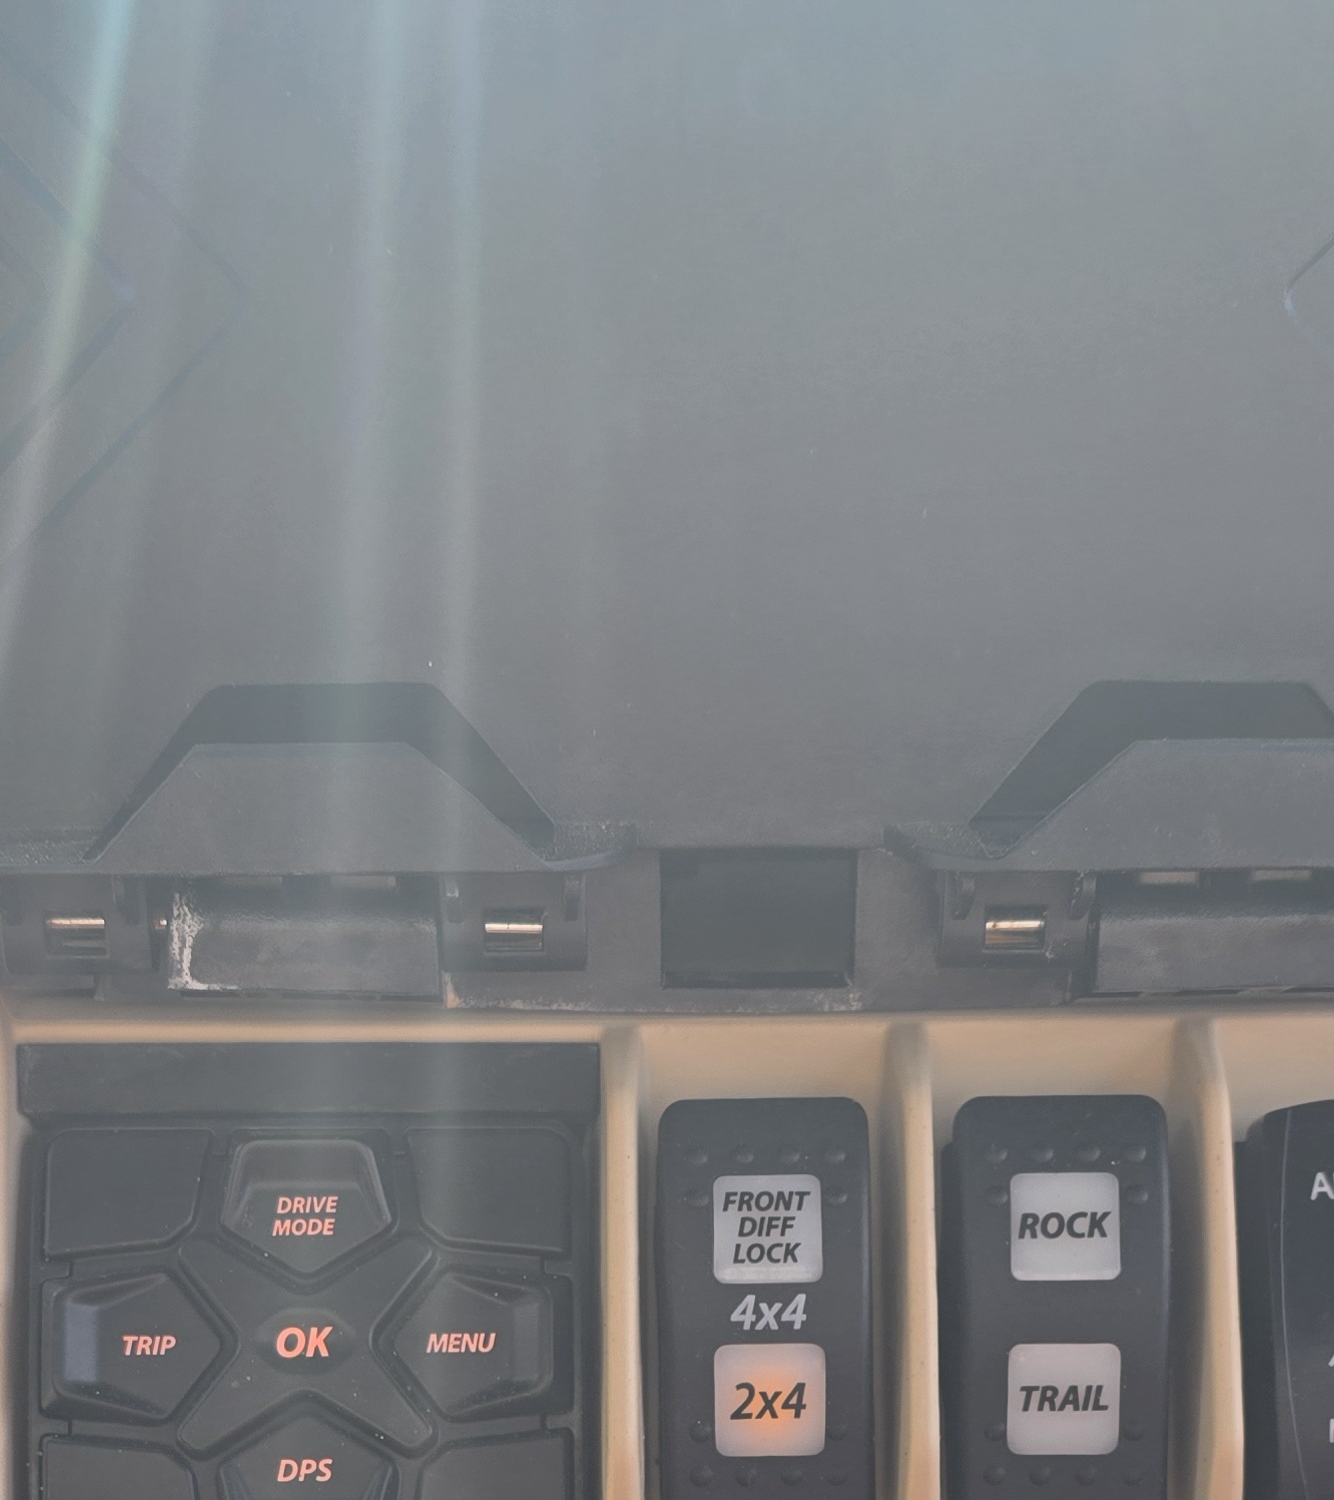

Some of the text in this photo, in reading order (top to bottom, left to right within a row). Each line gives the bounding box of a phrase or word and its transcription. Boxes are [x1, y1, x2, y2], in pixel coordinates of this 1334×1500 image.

[276, 1196, 338, 1214] DRIVE
[722, 1190, 810, 1213] FRONT
[272, 1219, 336, 1236] MODE
[737, 1216, 795, 1238] DIFF
[1018, 1211, 1111, 1240] ROCK
[732, 1242, 801, 1265] LOCK
[730, 1293, 807, 1331] 4x4
[121, 1335, 176, 1356] TRIP
[276, 1326, 333, 1358] OK
[426, 1333, 496, 1354] MENU
[730, 1382, 807, 1421] 2x4
[1019, 1385, 1109, 1413] TRAIL
[277, 1459, 333, 1482] DPS
